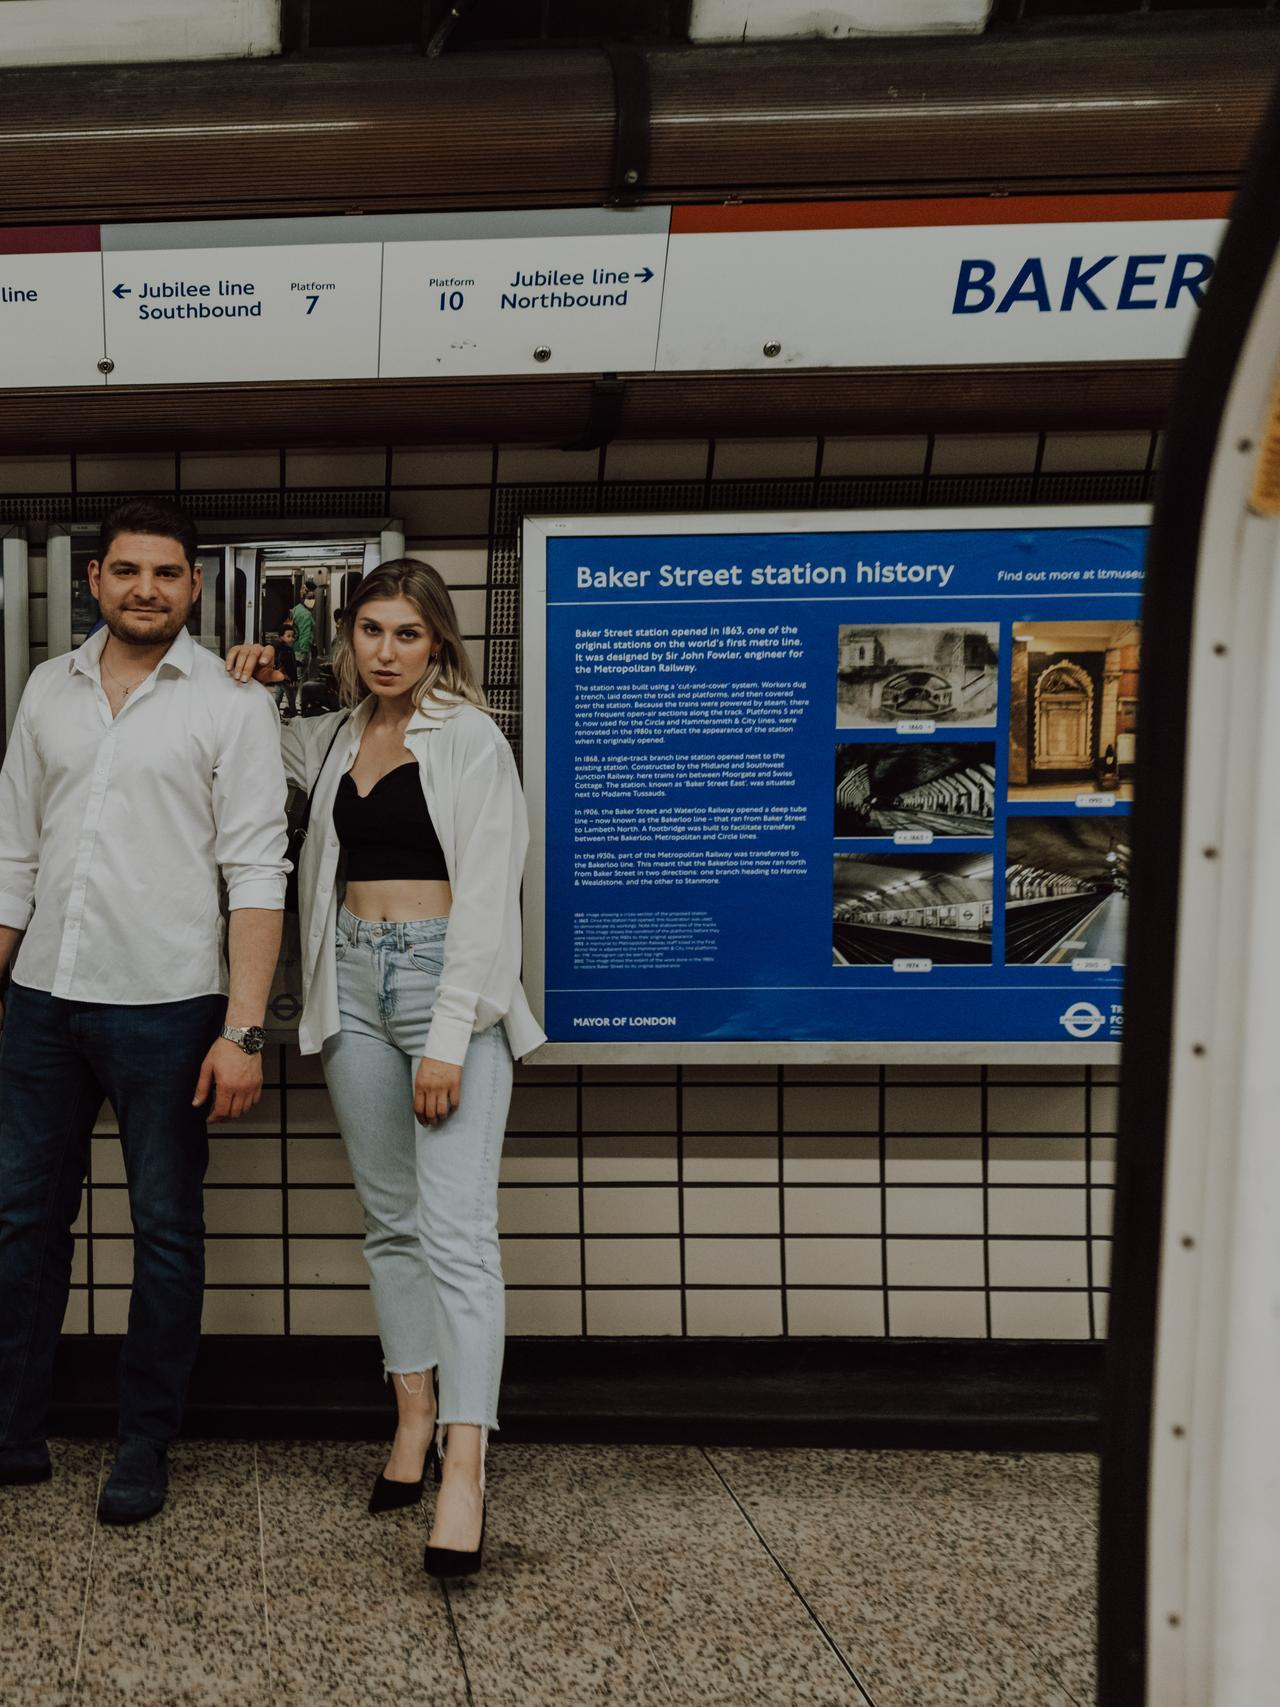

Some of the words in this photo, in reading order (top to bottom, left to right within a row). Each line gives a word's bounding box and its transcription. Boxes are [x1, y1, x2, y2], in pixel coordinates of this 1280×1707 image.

[429, 278, 474, 286] Platform
[510, 269, 584, 287] Jubilee
[592, 268, 629, 284] line
[952, 252, 1214, 316] BAKER
[138, 281, 210, 298] Jubilee
[219, 280, 254, 296] line
[290, 282, 335, 290] Platform
[2, 286, 37, 302] line
[440, 291, 464, 310] 10
[501, 290, 627, 309] Northbound
[139, 301, 261, 320] Southbound
[306, 295, 319, 314] 7
[577, 565, 651, 588] Baker
[659, 564, 742, 586] Street
[751, 562, 846, 585] station
[857, 560, 954, 588] history
[998, 570, 1022, 581] Find
[1024, 571, 1046, 581] out
[1048, 571, 1080, 580] more
[1082, 569, 1095, 579] at
[575, 628, 601, 637] Baker
[604, 628, 633, 637] Street
[635, 628, 669, 636] station
[671, 627, 708, 637] opened
[710, 627, 719, 635] in
[747, 627, 766, 635] one
[768, 625, 779, 634] of
[781, 625, 798, 634] the
[575, 641, 611, 651] original
[613, 640, 651, 649] stations
[669, 639, 685, 648] the
[688, 638, 724, 647] world's
[726, 638, 747, 647] first
[749, 638, 779, 647] metro
[575, 653, 583, 661] It
[606, 652, 649, 663] designed
[651, 652, 663, 662] by
[665, 651, 678, 660] Sir
[680, 651, 704, 659] John
[744, 650, 786, 660] engineer
[789, 649, 804, 658] for
[575, 665, 591, 673] the
[594, 664, 656, 675] Metropolitan
[603, 737, 636, 745] originally
[648, 825, 685, 833] footbridge
[657, 851, 704, 859] Metropolitan
[573, 1017, 610, 1026] MAYOR
[612, 1017, 627, 1026] OF
[629, 1016, 676, 1026] LONDON
